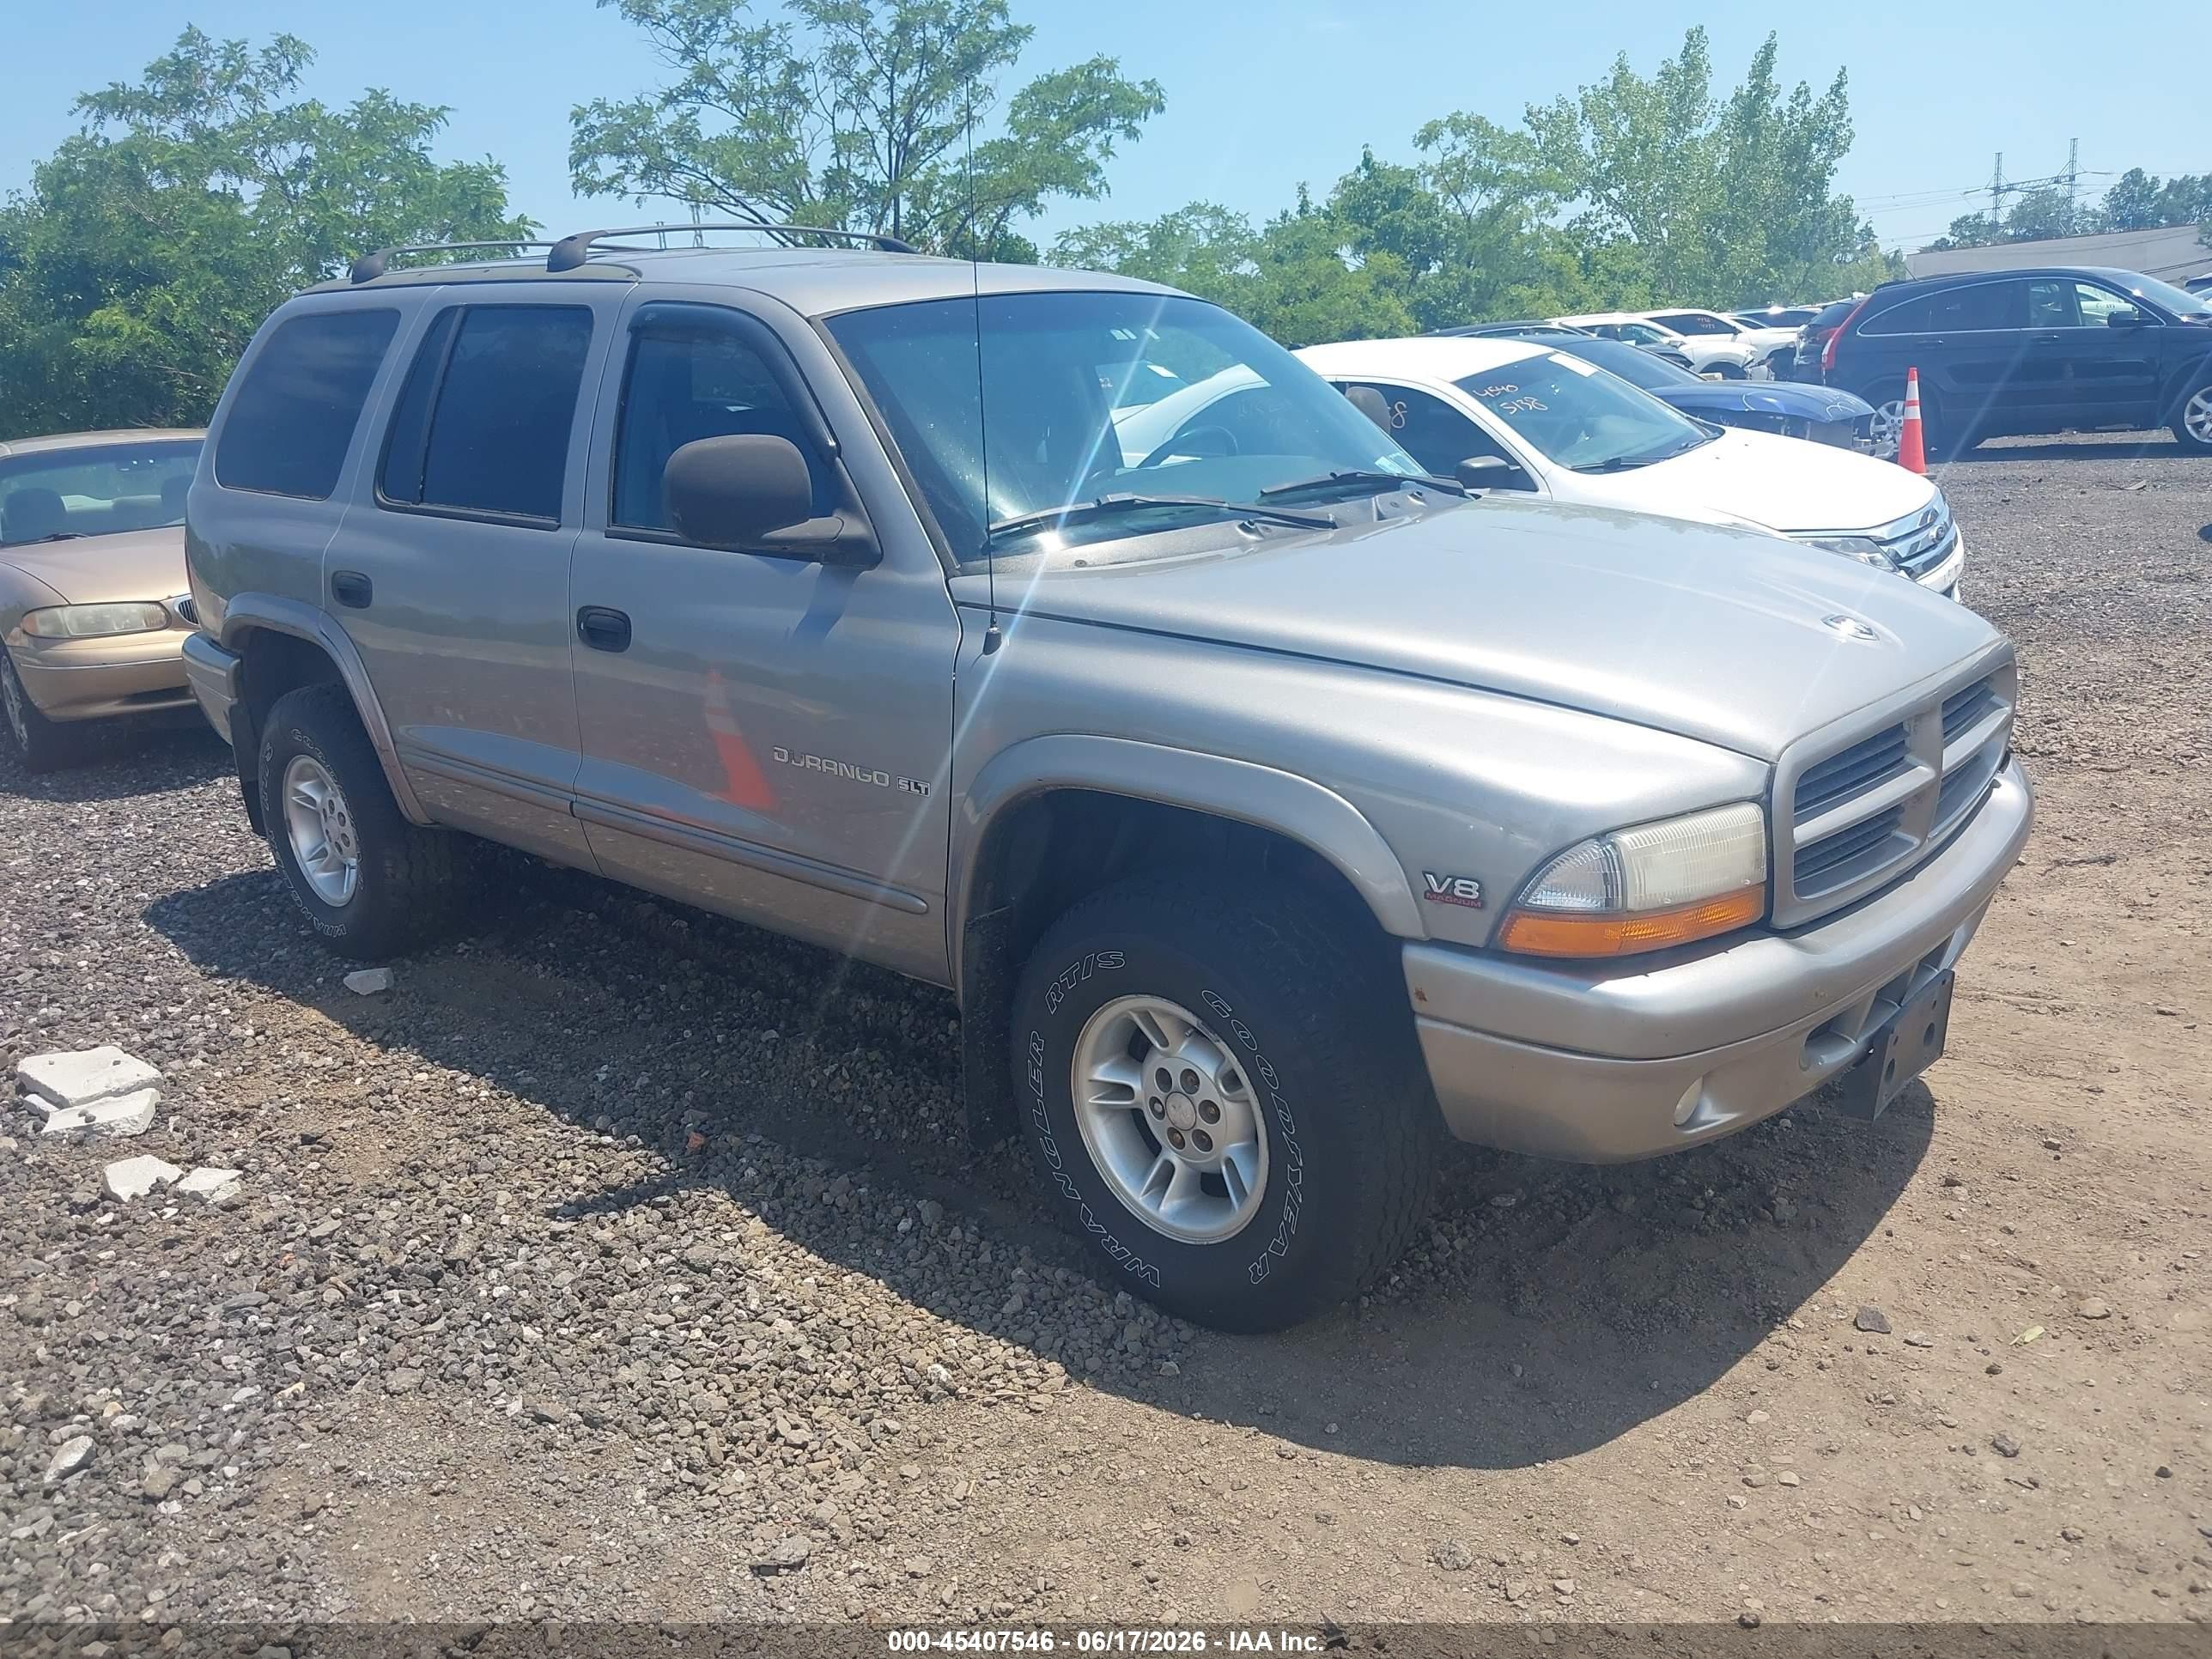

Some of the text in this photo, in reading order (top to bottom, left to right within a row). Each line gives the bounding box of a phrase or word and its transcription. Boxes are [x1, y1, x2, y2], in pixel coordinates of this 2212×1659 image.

[1473, 384, 1519, 398] 4540
[1499, 397, 1548, 415] 5138
[773, 746, 930, 795] DURANGO SLT
[1424, 872, 1480, 900] V8
[1425, 892, 1482, 908] MAGNUM
[1202, 989, 1304, 1285] GOODYEAR
[1028, 1030, 1160, 1288] WRANGLER
